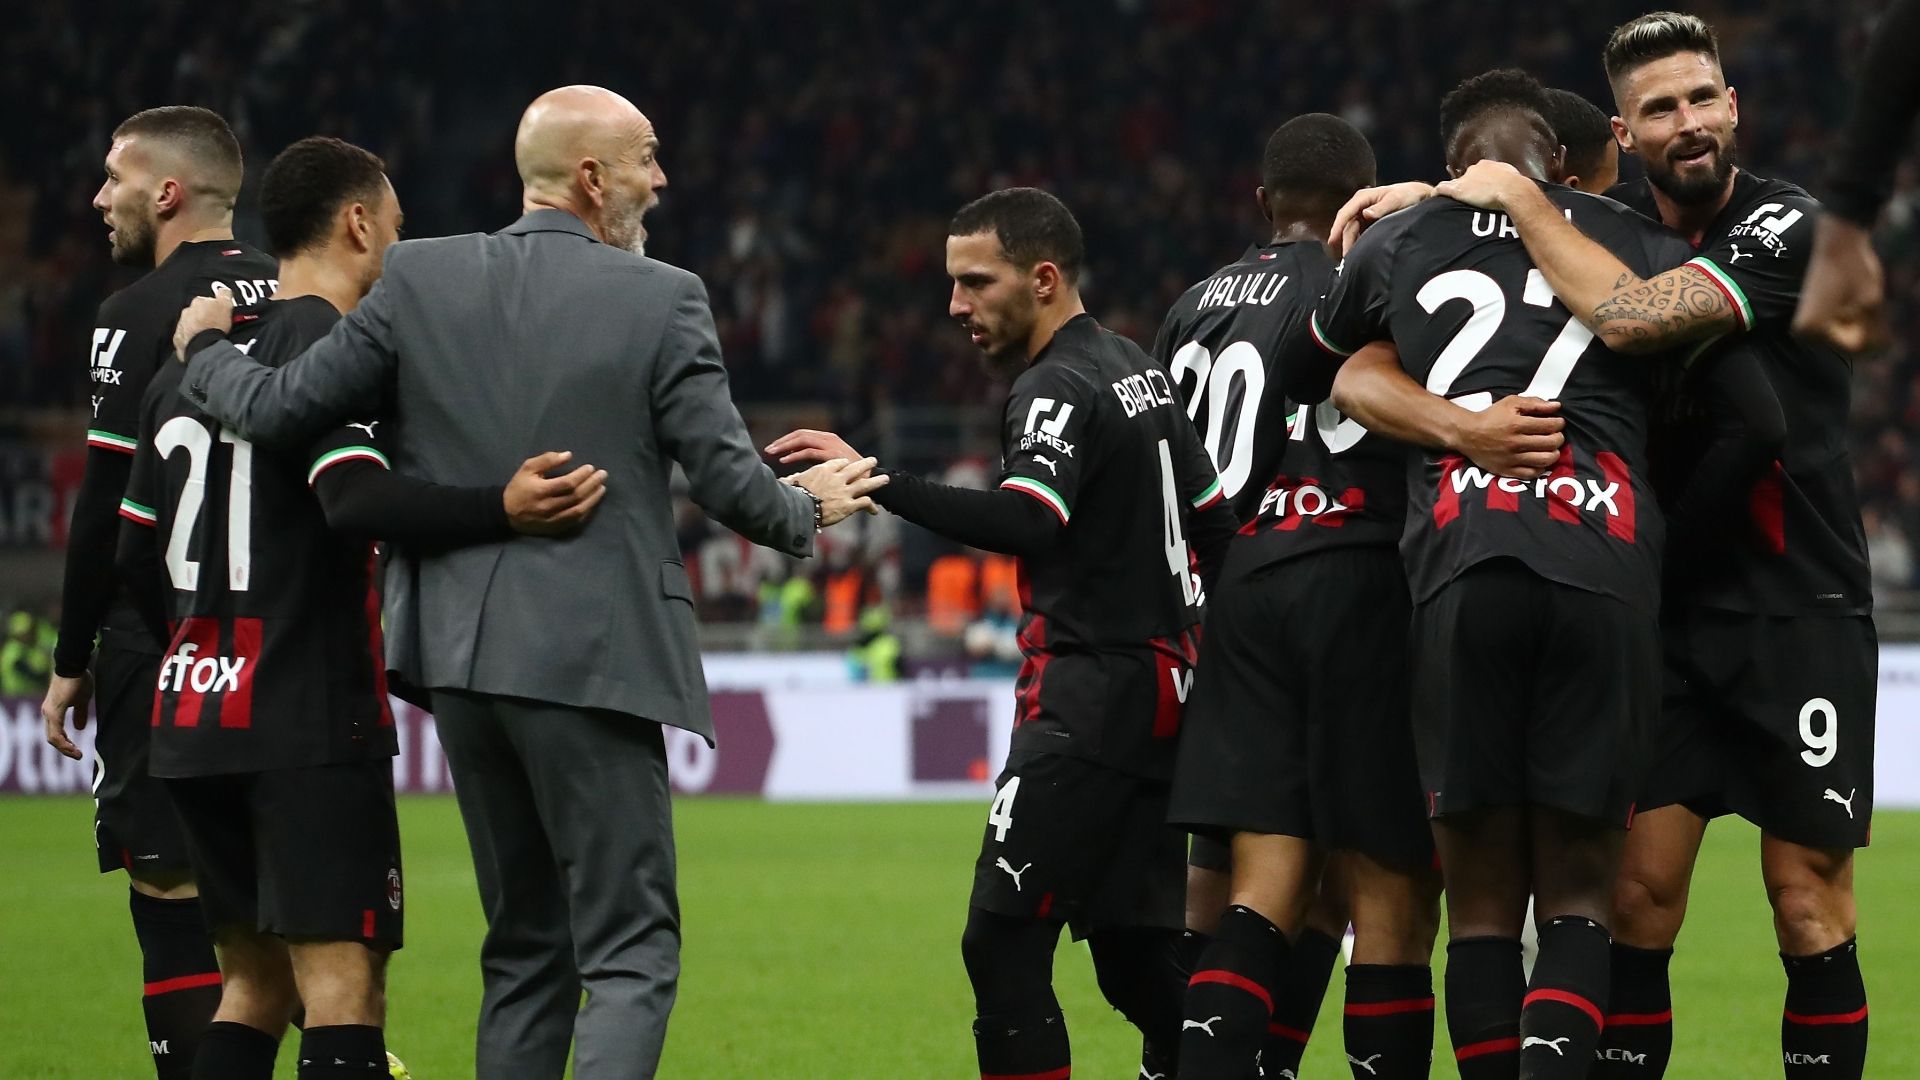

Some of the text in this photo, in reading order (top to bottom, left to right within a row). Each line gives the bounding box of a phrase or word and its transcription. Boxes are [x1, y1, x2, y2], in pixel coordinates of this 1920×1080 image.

[1020, 430, 1075, 458] BitMEX
[1170, 339, 1266, 500] 20
[154, 416, 252, 592] 21
[1158, 437, 1196, 607] 4
[1798, 697, 1838, 768] 9
[988, 775, 1021, 843] 4
[1784, 1051, 1831, 1065] ACM
